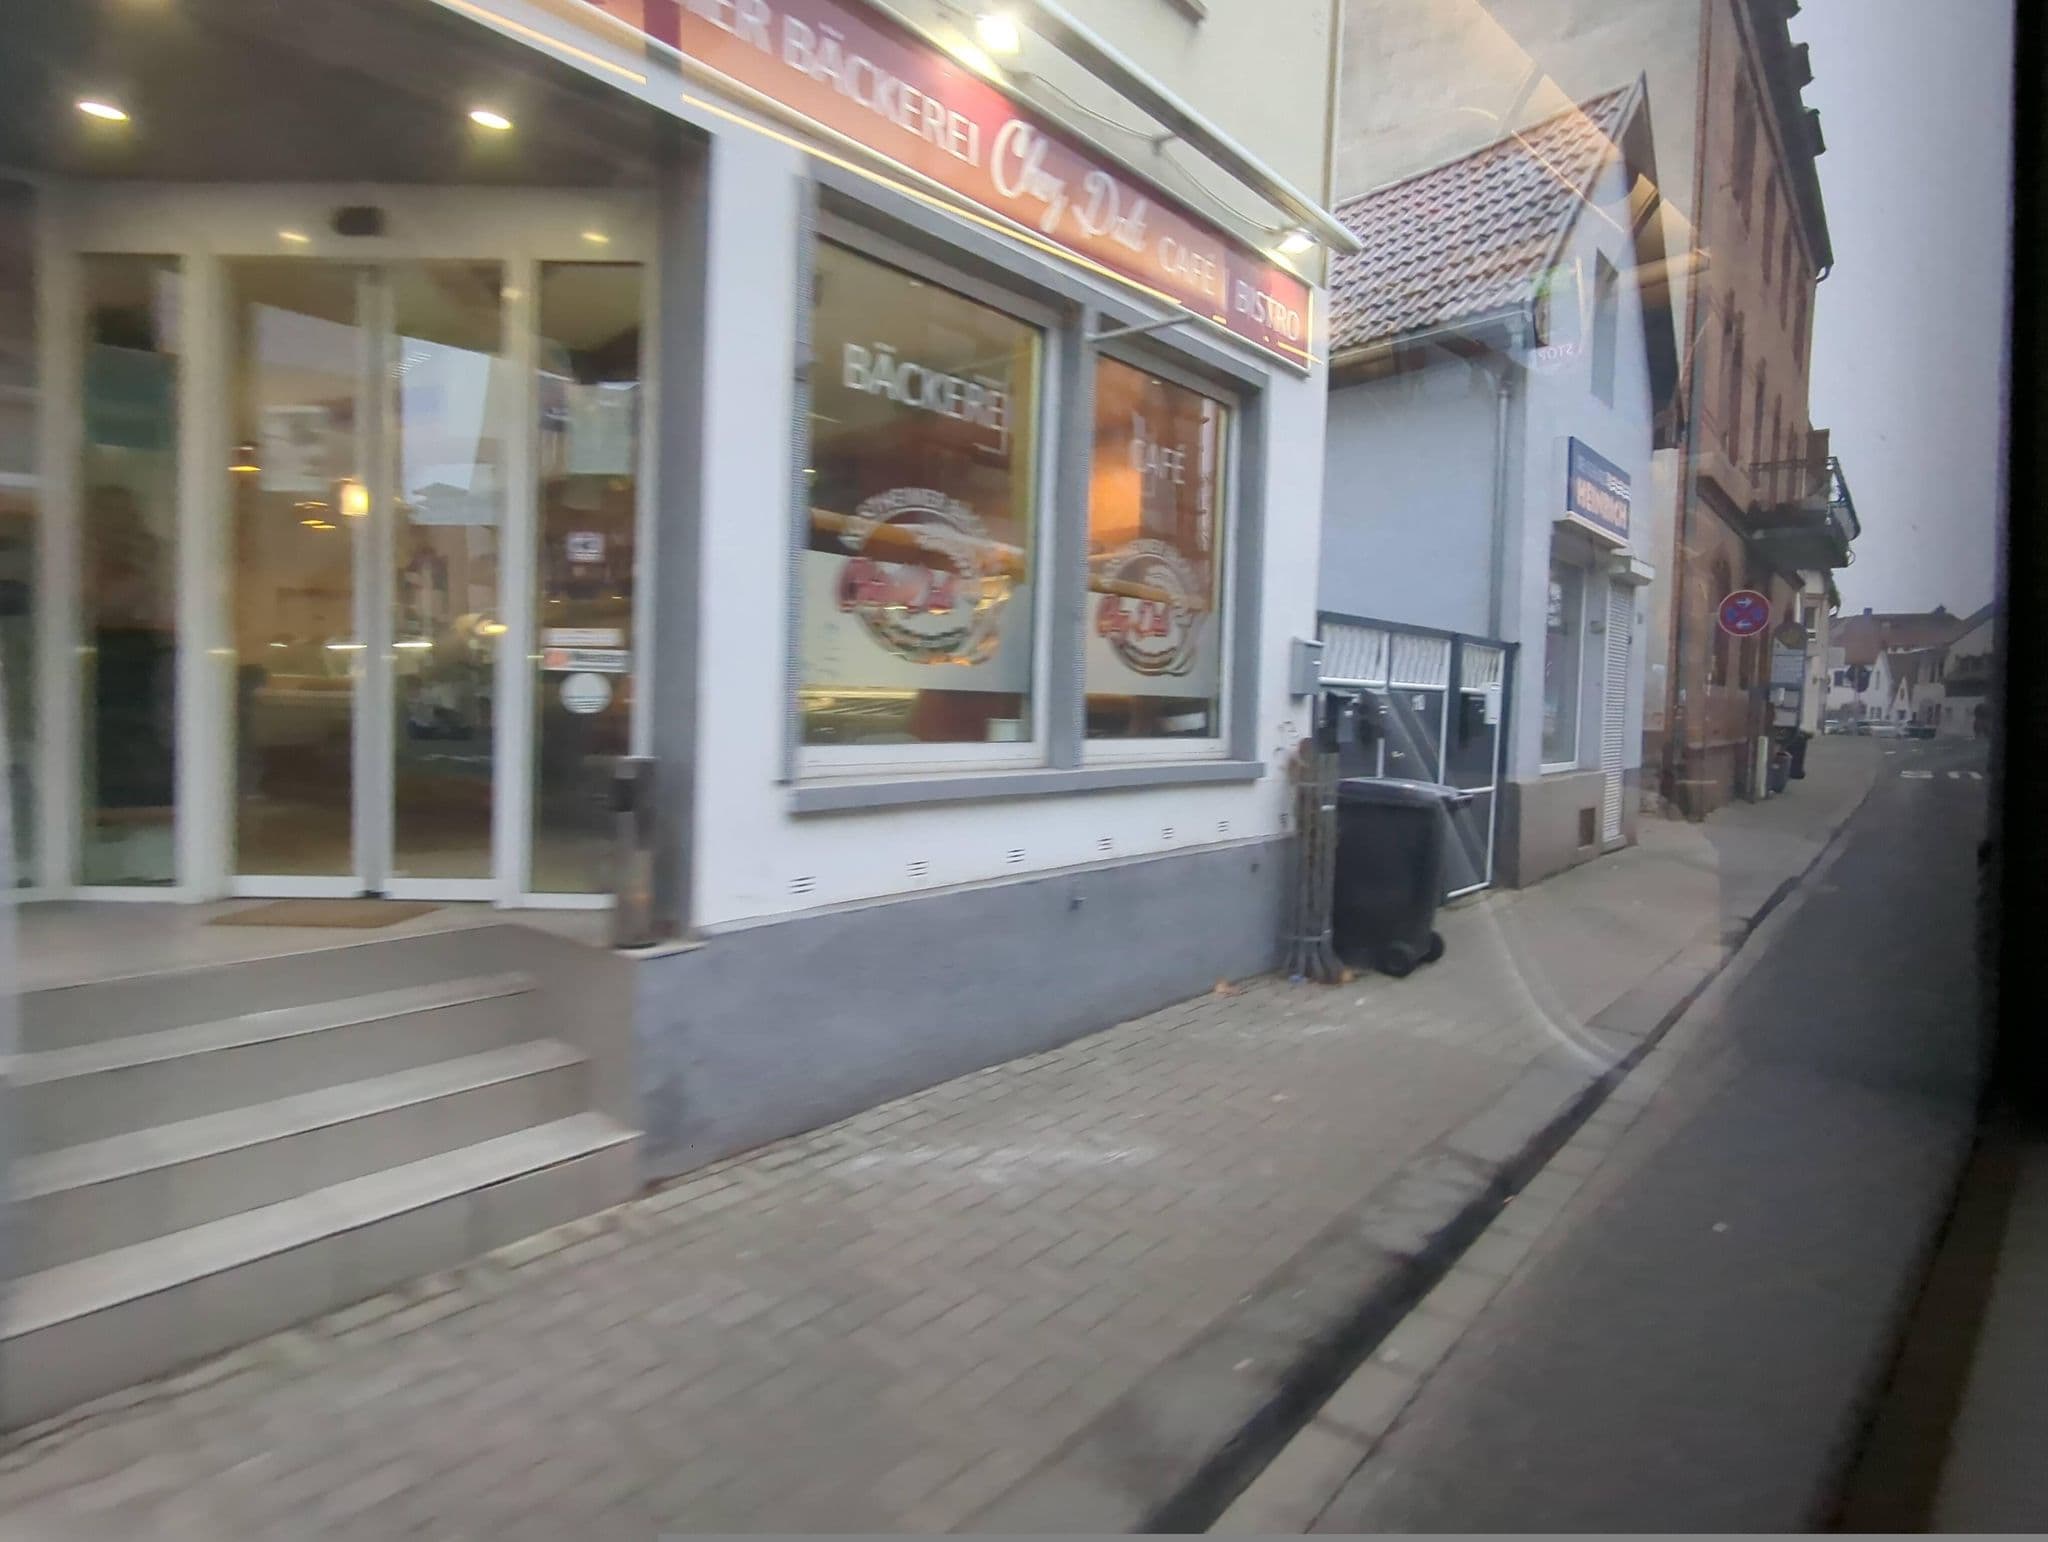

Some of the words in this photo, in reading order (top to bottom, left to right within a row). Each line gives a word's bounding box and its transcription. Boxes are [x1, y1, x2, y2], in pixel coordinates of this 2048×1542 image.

[783, 14, 980, 168] BÄCKEREI
[1234, 279, 1301, 342] BISTRO
[842, 340, 1010, 435] BÄCKEREI
